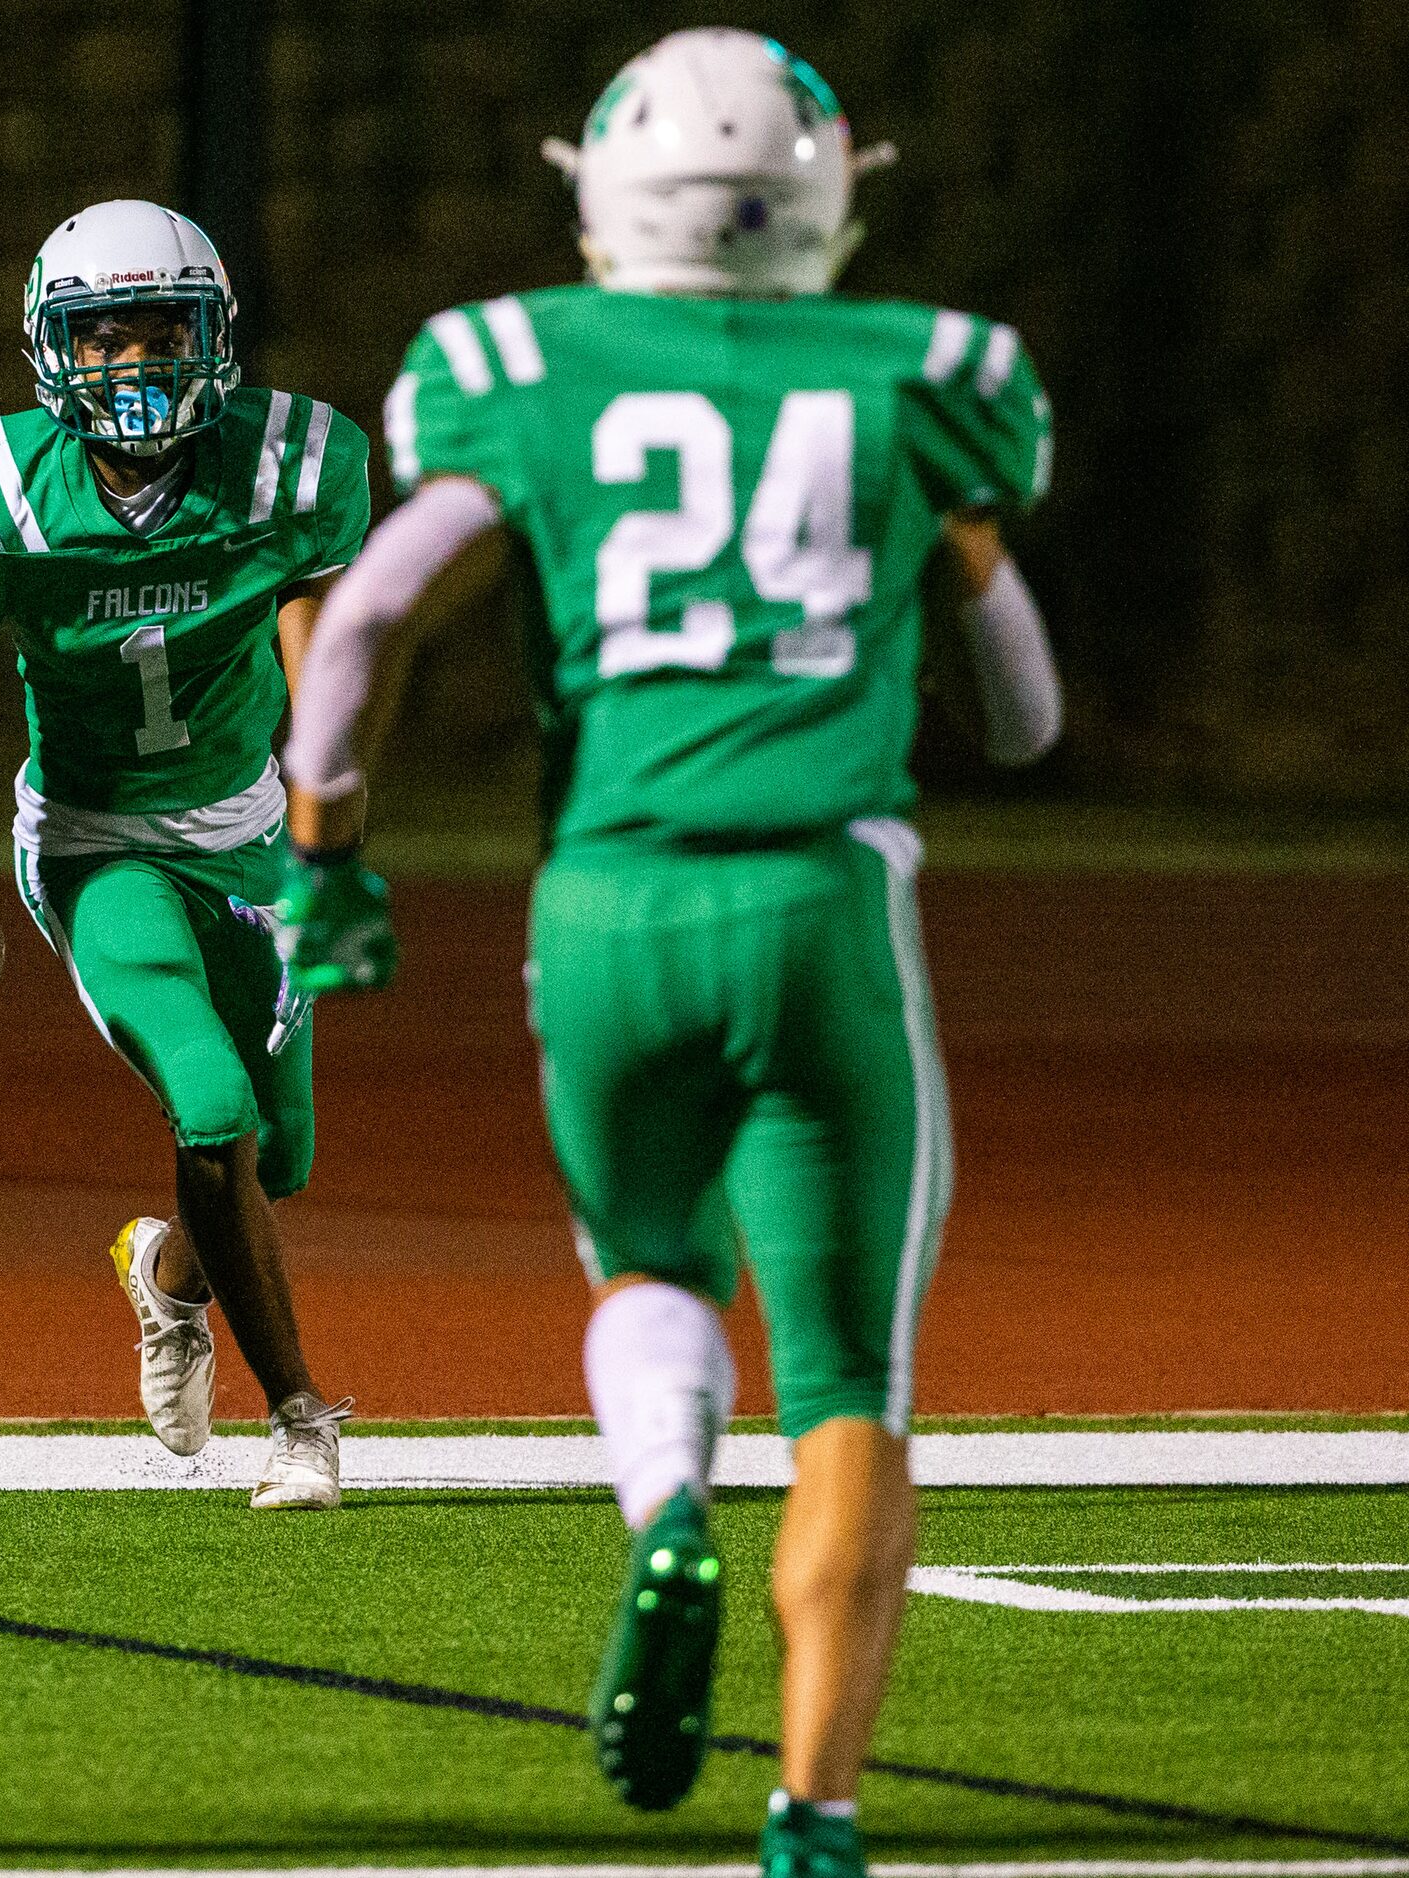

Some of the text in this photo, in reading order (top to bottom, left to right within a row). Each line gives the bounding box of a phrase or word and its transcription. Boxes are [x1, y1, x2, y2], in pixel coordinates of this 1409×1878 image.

[112, 270, 154, 283] Riddell
[592, 390, 873, 679] 24
[87, 579, 208, 620] FALCONS
[120, 625, 190, 756] 1
